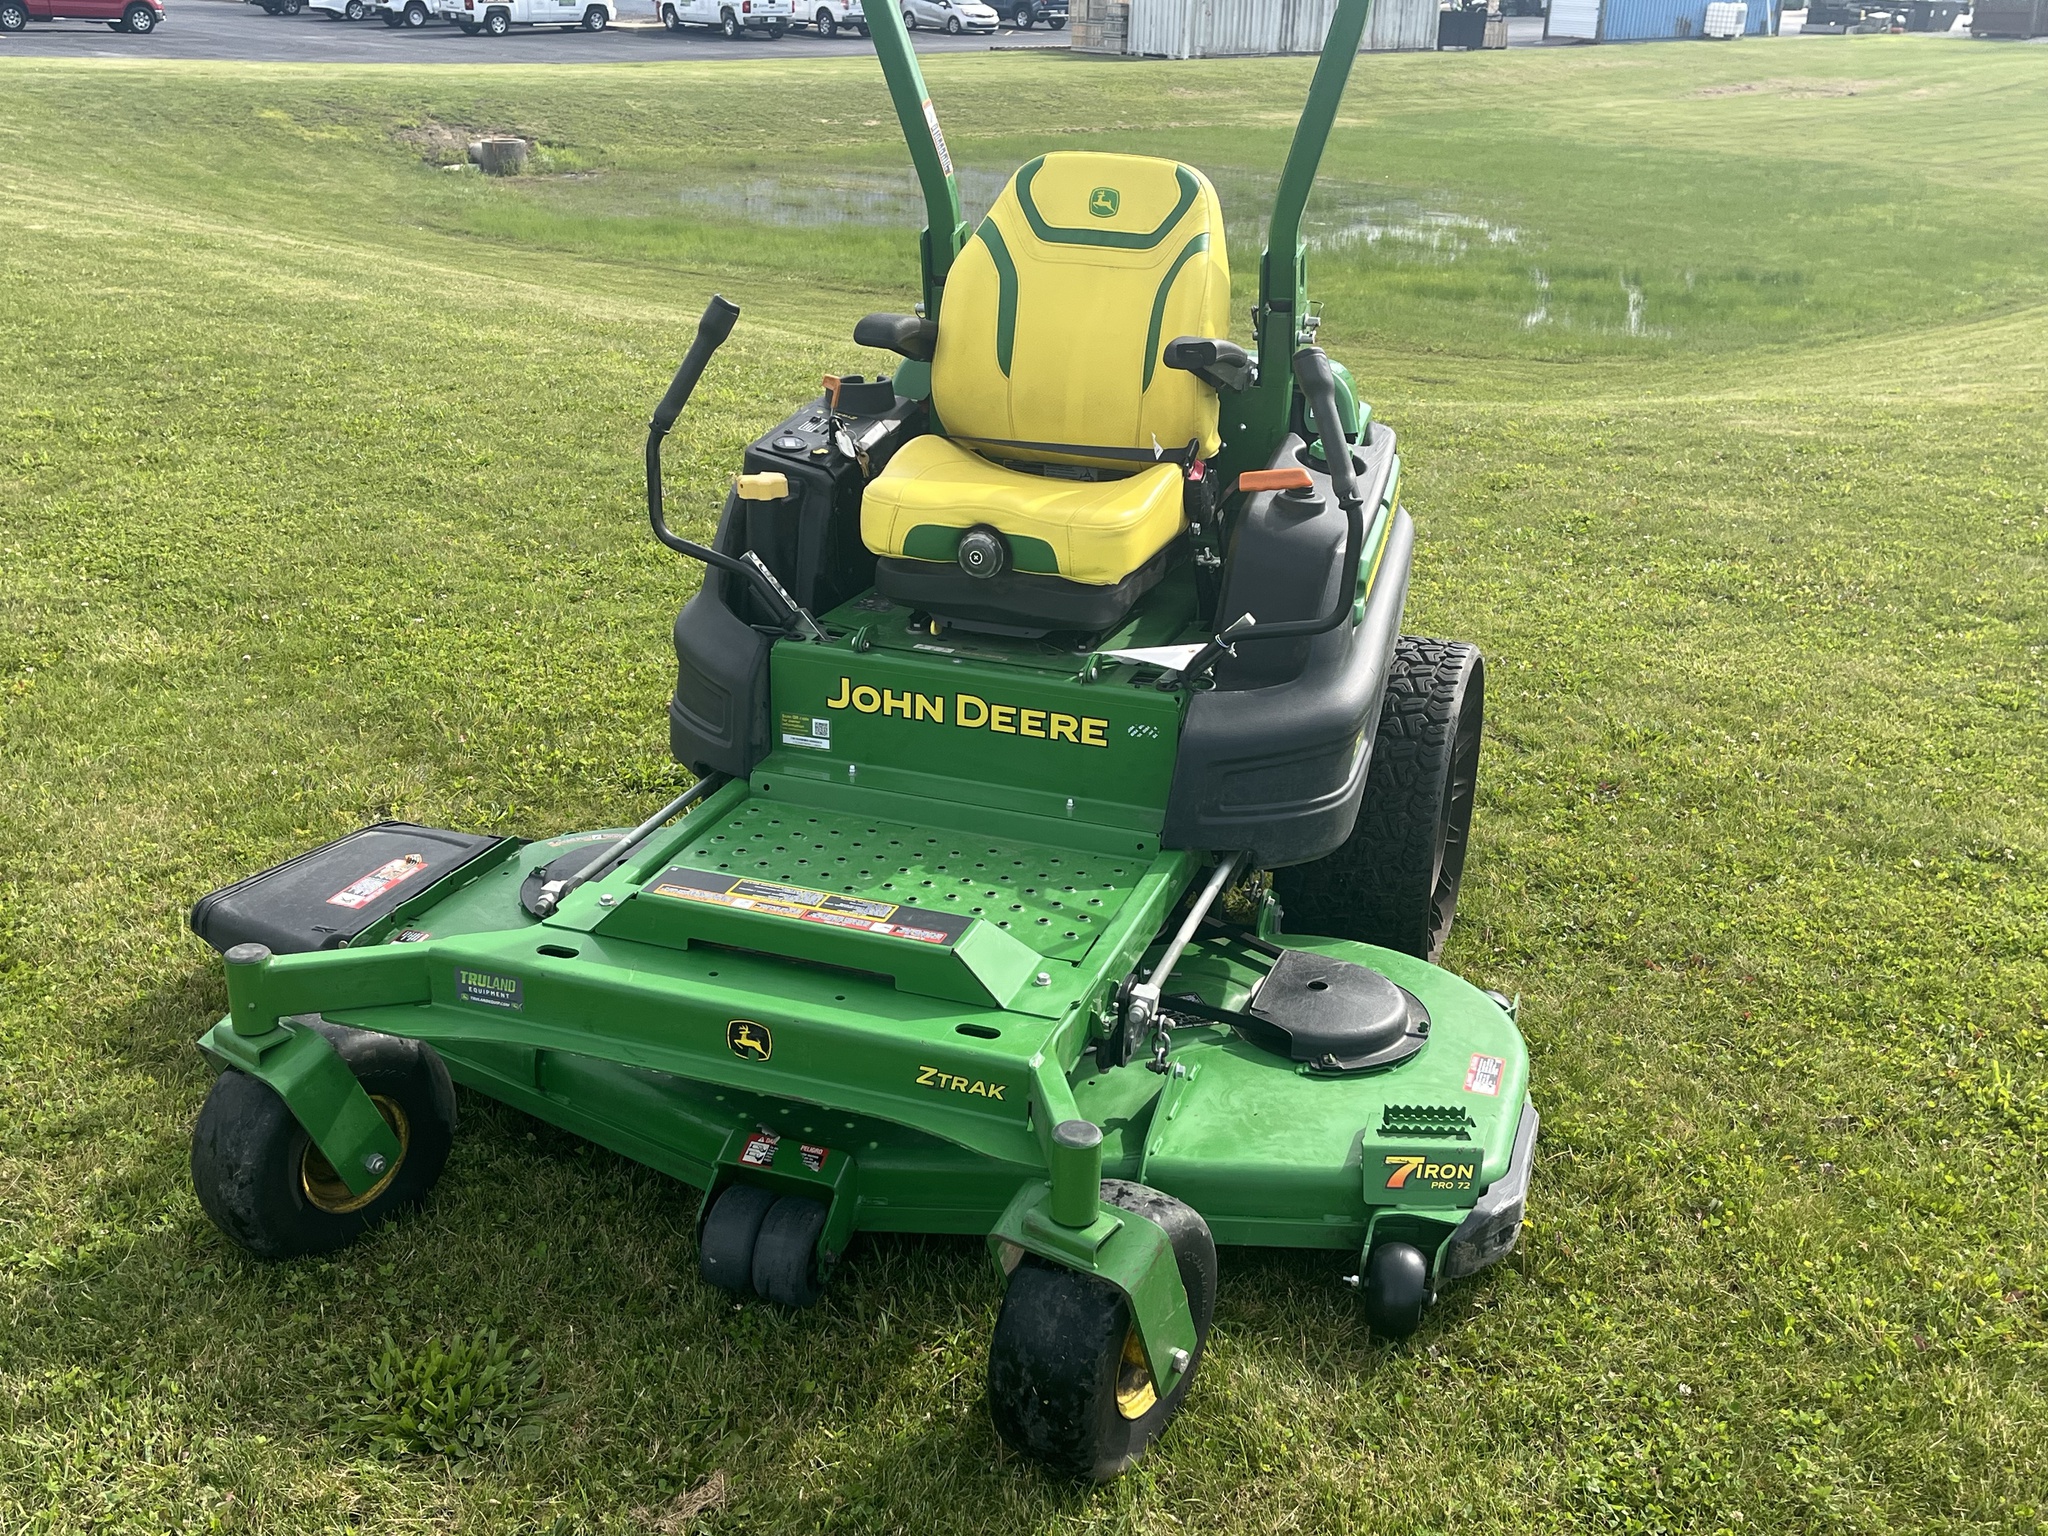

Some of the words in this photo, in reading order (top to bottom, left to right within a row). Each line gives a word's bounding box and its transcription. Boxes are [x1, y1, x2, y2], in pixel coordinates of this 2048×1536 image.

[827, 676, 943, 724] JOHN
[956, 692, 1109, 747] DEERE
[460, 971, 516, 992] TRULAND
[468, 986, 509, 998] EQUIPMENT
[915, 1065, 1007, 1100] ZTRAK
[1431, 1181, 1453, 1189] PRO
[1457, 1181, 1471, 1190] 72
